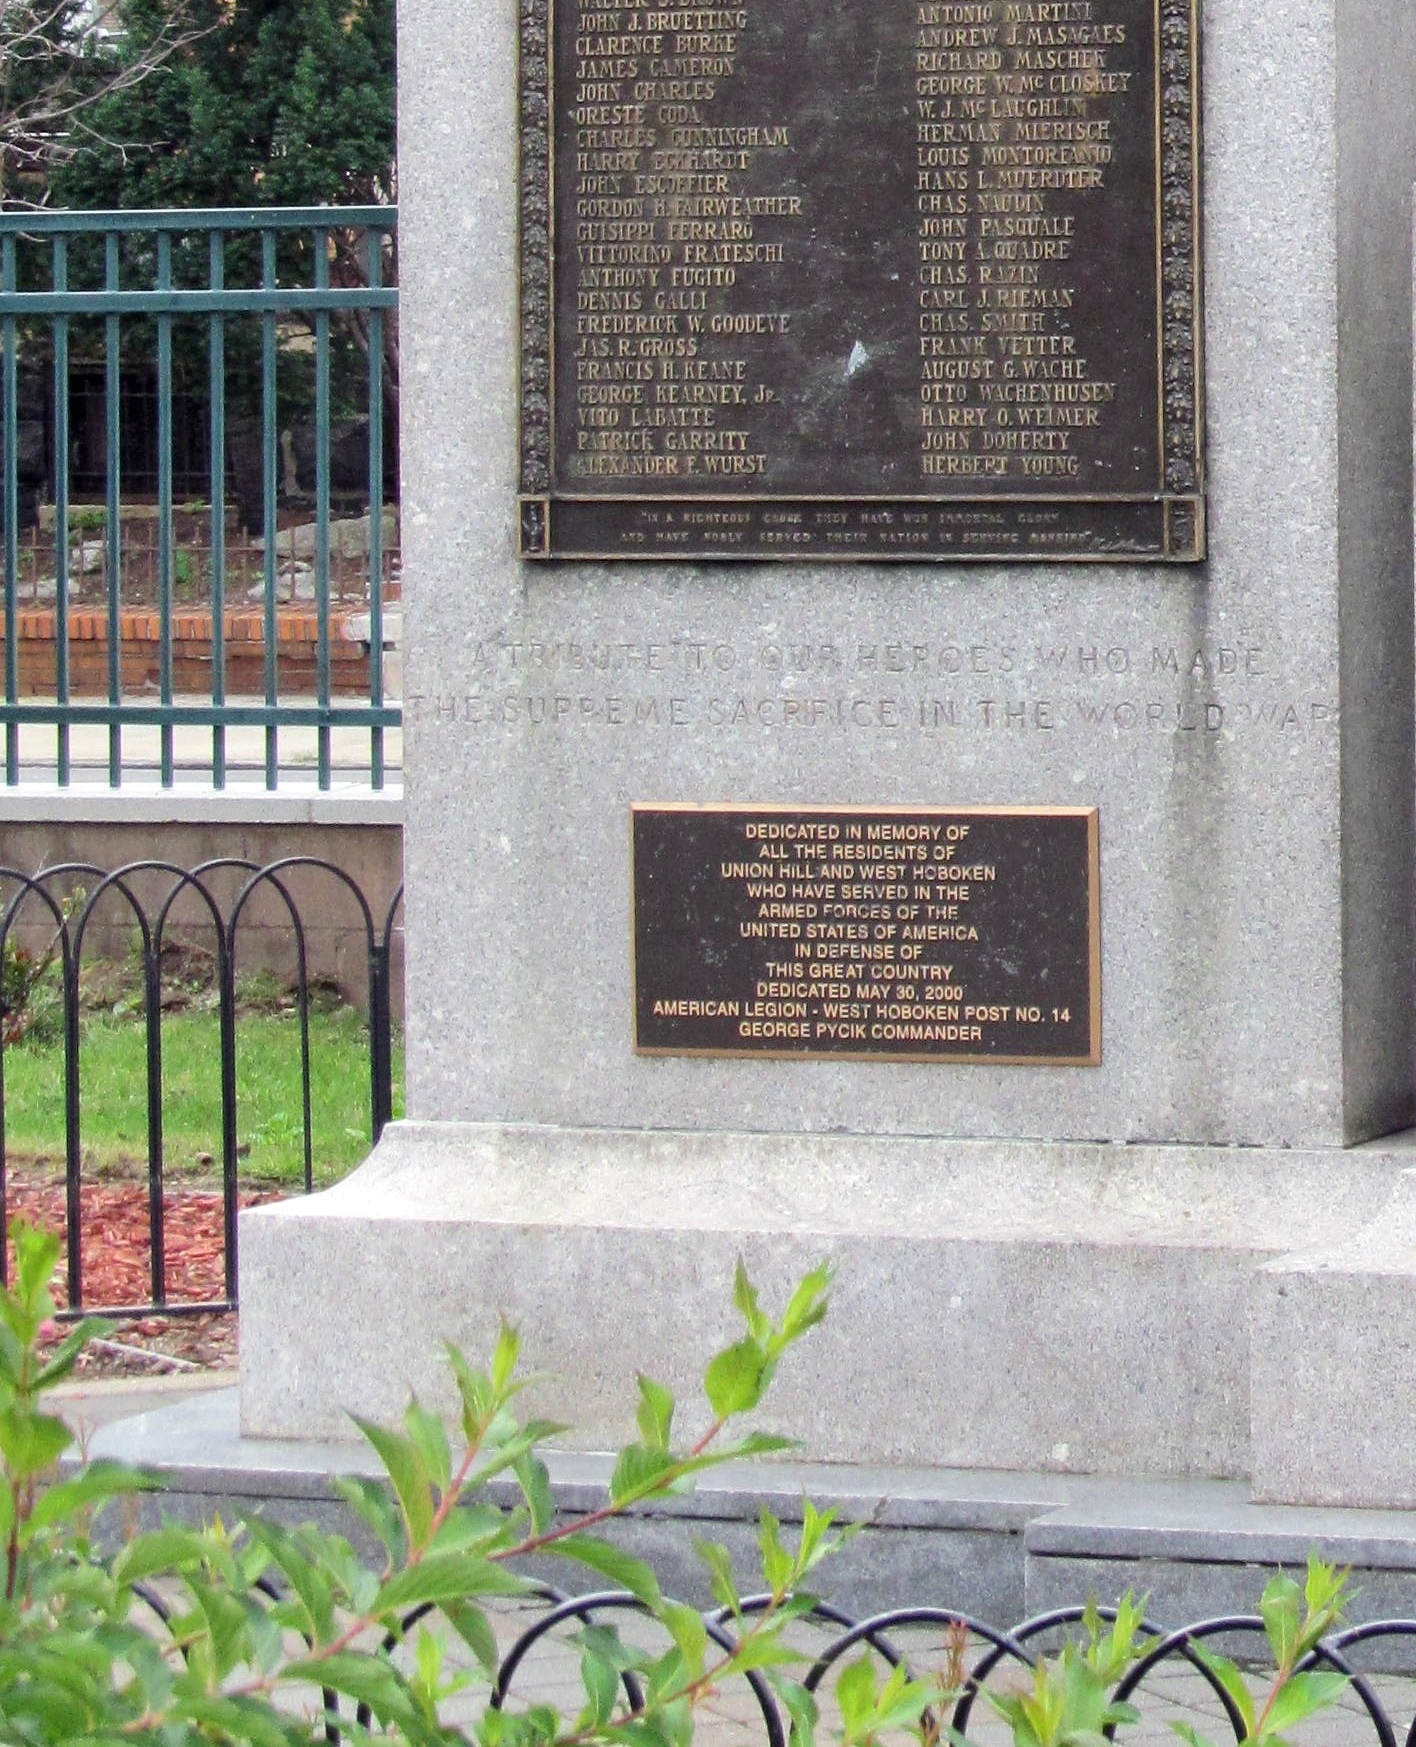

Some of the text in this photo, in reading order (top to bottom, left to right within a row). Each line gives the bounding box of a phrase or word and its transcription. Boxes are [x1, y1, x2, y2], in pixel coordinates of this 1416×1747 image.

[577, 35, 736, 55] CLARENCE BURKE
[577, 59, 735, 78] JAMES CAMERON
[577, 82, 715, 101] JOHN CHARLES
[577, 106, 644, 124] ORESTE
[919, 219, 967, 237] JOHN
[578, 292, 642, 310] DENNIS
[920, 290, 968, 308] CARL
[578, 316, 677, 334] FREDERICK
[689, 316, 704, 332] W.
[921, 337, 1075, 355] FRANK VETTER
[577, 362, 653, 380] FRANCIS
[921, 361, 994, 379] AUGUST
[1024, 360, 1087, 378] WACHE
[921, 408, 987, 426] HARRY
[1019, 408, 1100, 426] WEIMER
[578, 432, 748, 450] PATRICK GARRITY
[922, 432, 1070, 450] JOHN DOHERTY
[471, 641, 1266, 676] A TRIBUTE TO OUR HEROES WHO MADE
[407, 696, 482, 724] THE
[500, 696, 688, 726] SUPREME
[709, 698, 898, 728] SACRIFICE
[919, 699, 957, 729] IN
[976, 700, 1055, 731] THE
[1078, 702, 1225, 732] WORLD
[746, 824, 969, 840] DEDICATED IN MEMORY OF
[760, 845, 954, 860] ALL THE RESIDENTS OF
[722, 863, 995, 880] UNION HILL AND WEST HOBOKEN
[747, 884, 969, 900] WHO HAVE SERVED IN THE
[759, 904, 957, 919] ARMED FORCES OF THE
[741, 923, 978, 939] UNITED STATES OF AMERICA
[796, 944, 922, 959] IN DEFENSE OF
[766, 963, 952, 979] THIS GREAT COUNTRY
[757, 983, 962, 1000] DEDICATED MAY 30, 2000
[654, 1001, 739, 1015] AMERICAN
[746, 1003, 806, 1017] LEGION
[824, 1004, 871, 1018] WEST
[877, 1005, 958, 1019] HOBOKEN
[965, 1006, 1010, 1021] POST
[1016, 1007, 1044, 1021] NO.
[1053, 1009, 1069, 1022] 14
[740, 1022, 981, 1040] GEORGE PYCIK COMMANDER
